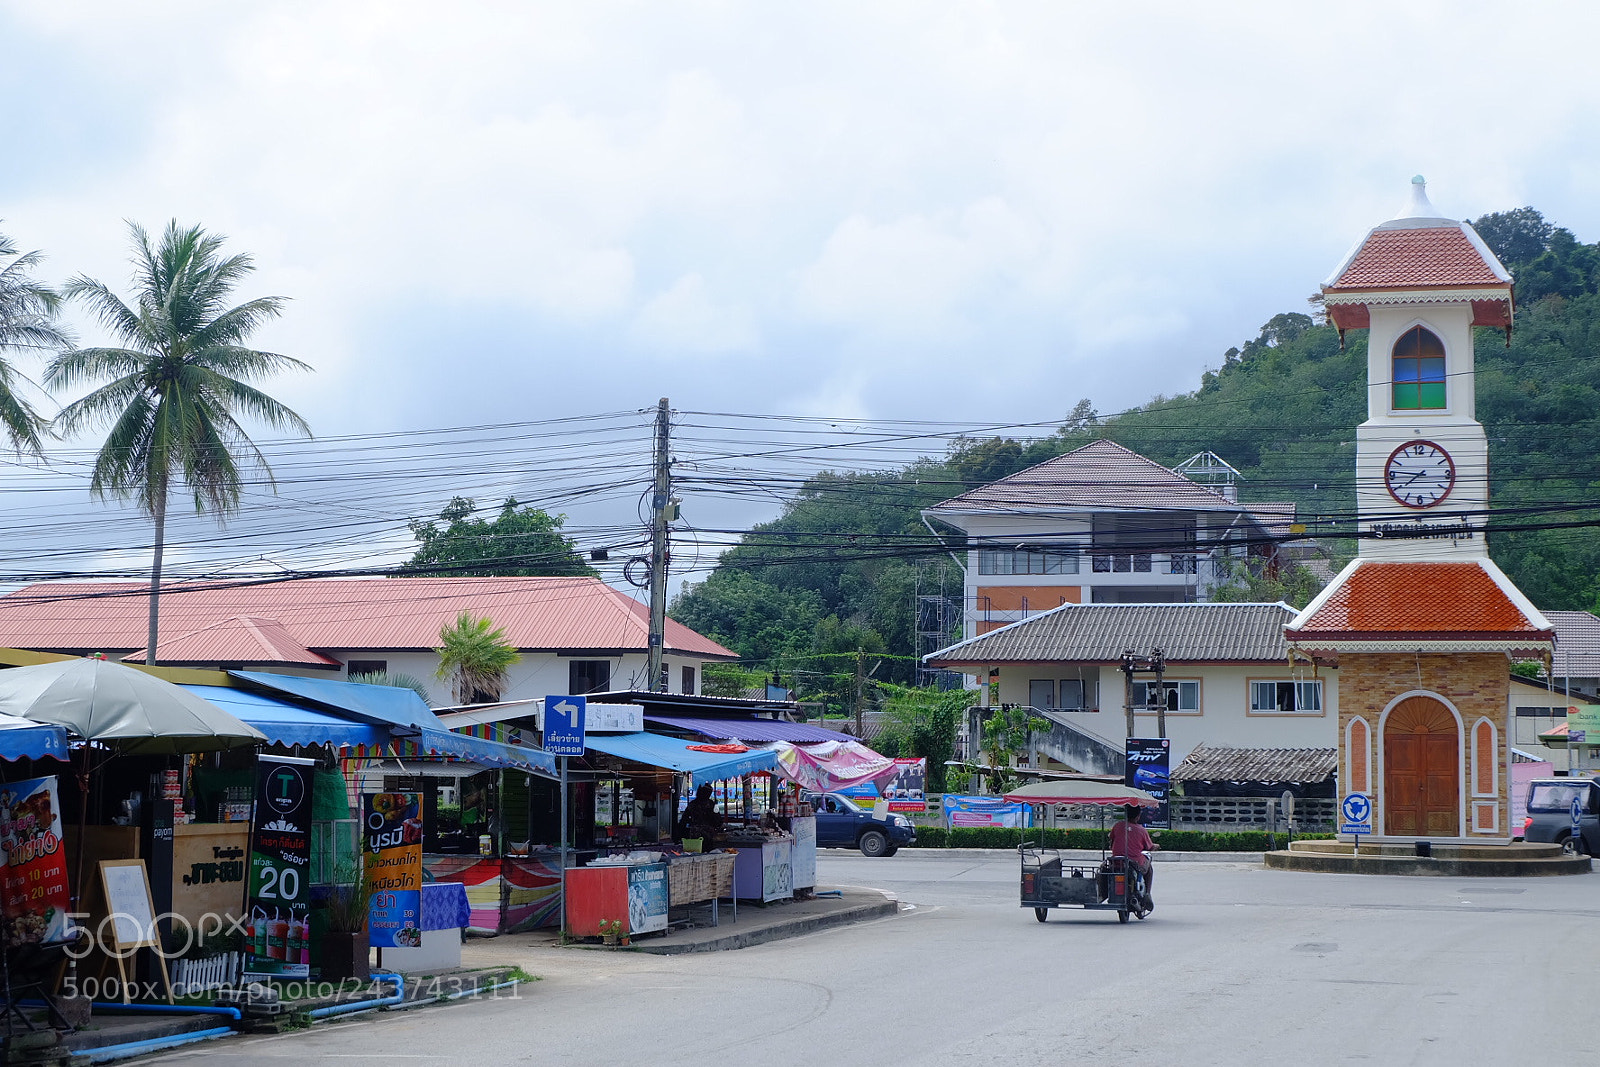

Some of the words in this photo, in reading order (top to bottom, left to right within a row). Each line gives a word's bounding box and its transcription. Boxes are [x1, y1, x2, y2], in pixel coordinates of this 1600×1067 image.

[1413, 445, 1424, 455] 12
[1444, 470, 1451, 479] 3
[1417, 495, 1424, 505] 6
[277, 774, 295, 797] T
[369, 825, 403, 854] นูรมี
[28, 869, 41, 882] 10
[44, 867, 60, 879] บาท
[258, 867, 299, 901] 20
[31, 886, 44, 900] 20
[46, 884, 63, 896] บาท
